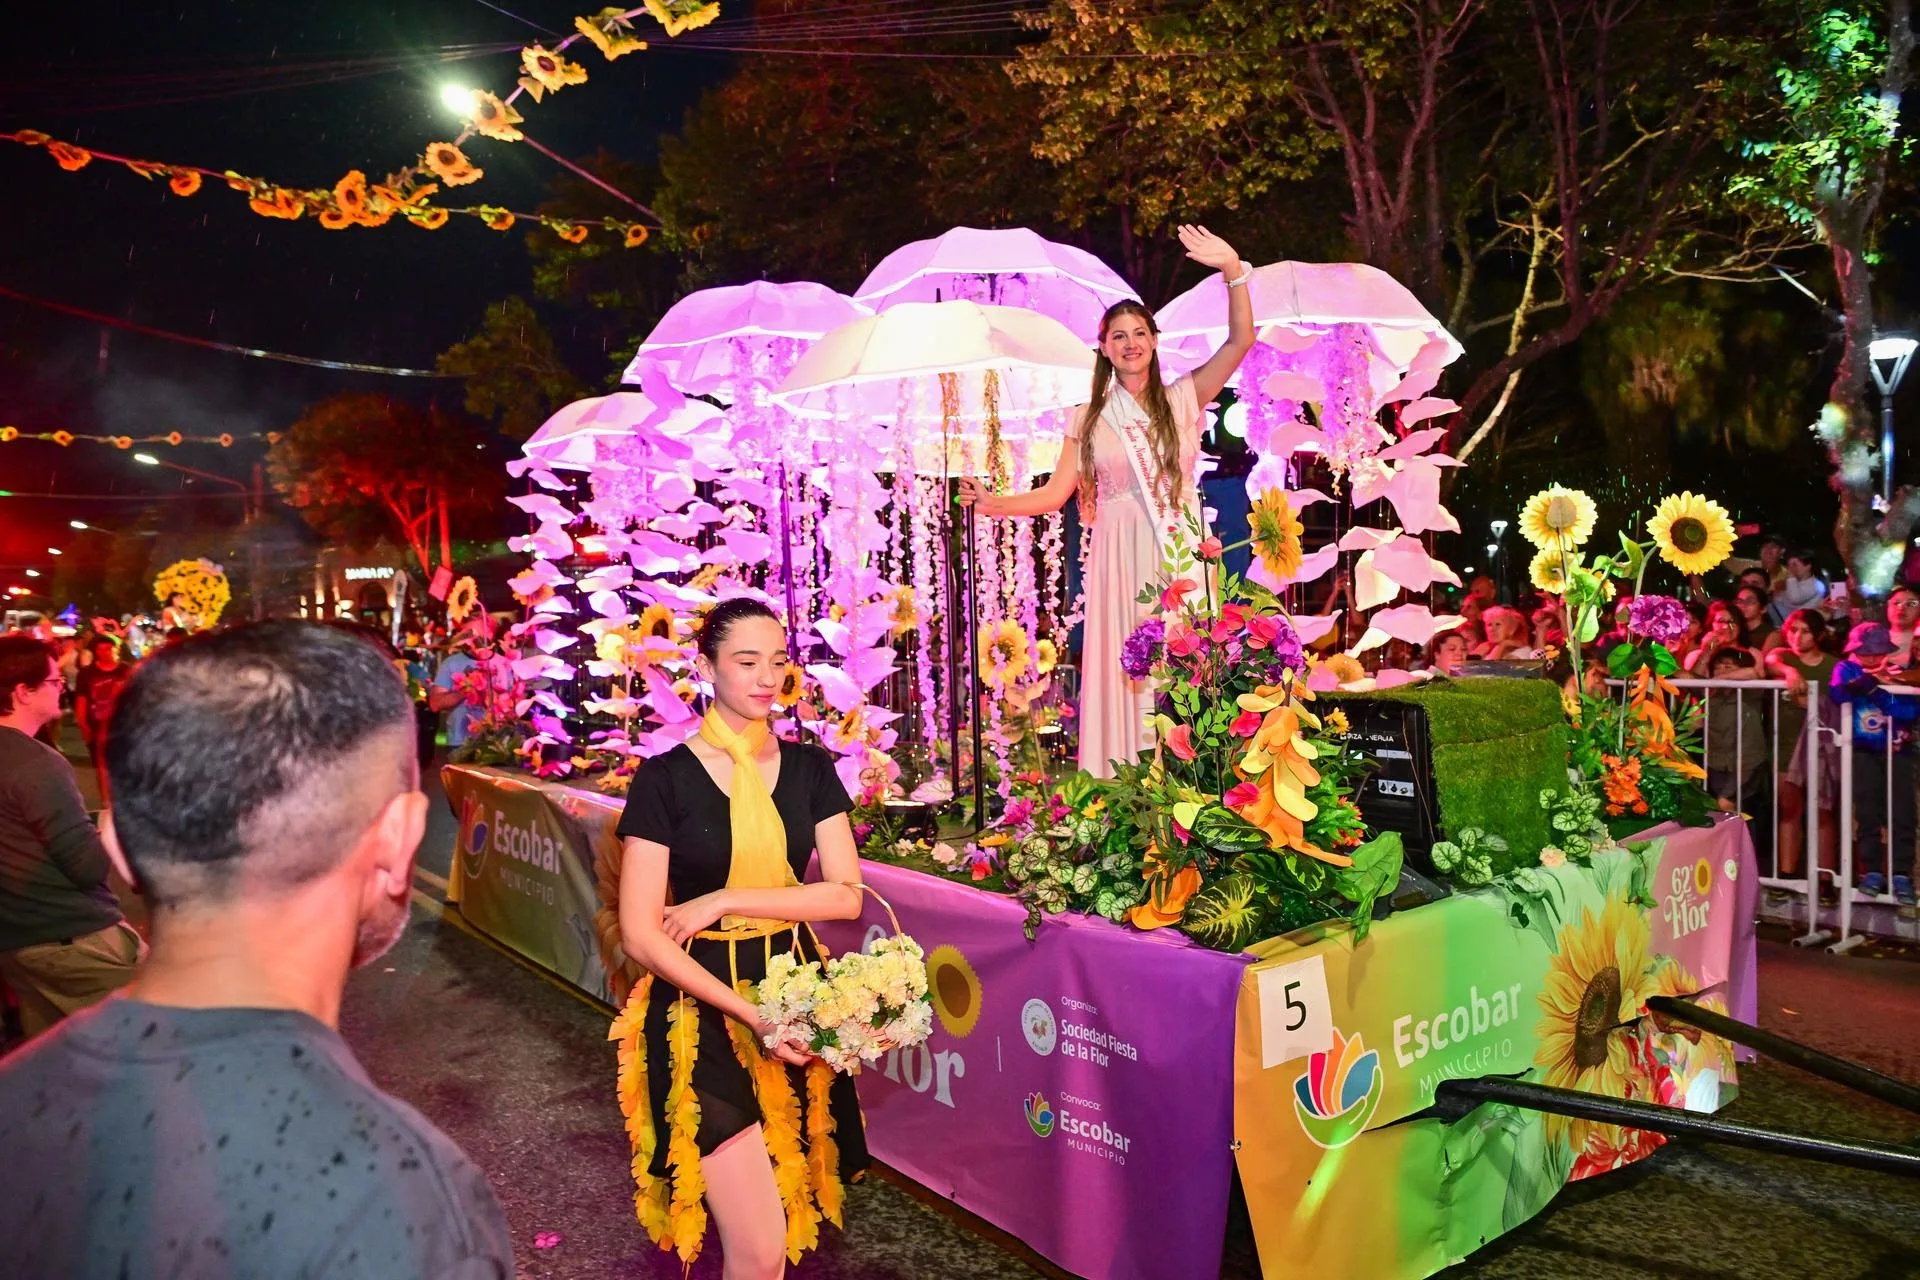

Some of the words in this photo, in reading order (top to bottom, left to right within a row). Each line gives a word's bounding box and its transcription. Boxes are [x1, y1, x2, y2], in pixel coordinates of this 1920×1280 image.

[494, 810, 563, 875] Escobar
[500, 866, 554, 906] MUNICIPIO
[1664, 895, 1709, 939] Flor
[1061, 996, 1098, 1016] Organiza:
[1284, 981, 1307, 1032] 5
[1393, 983, 1522, 1068] Escobar
[1061, 1019, 1107, 1048] Sociedad
[1108, 1035, 1138, 1062] Fiesta
[1061, 1039, 1075, 1057] de
[1077, 1042, 1088, 1060] la
[1091, 1046, 1109, 1068] Flor
[1420, 1038, 1512, 1099] MUNICIPIO
[1060, 1091, 1101, 1111] Convoca:
[1060, 1109, 1131, 1153] Escobar
[1067, 1137, 1126, 1166] MUNICIPIO
